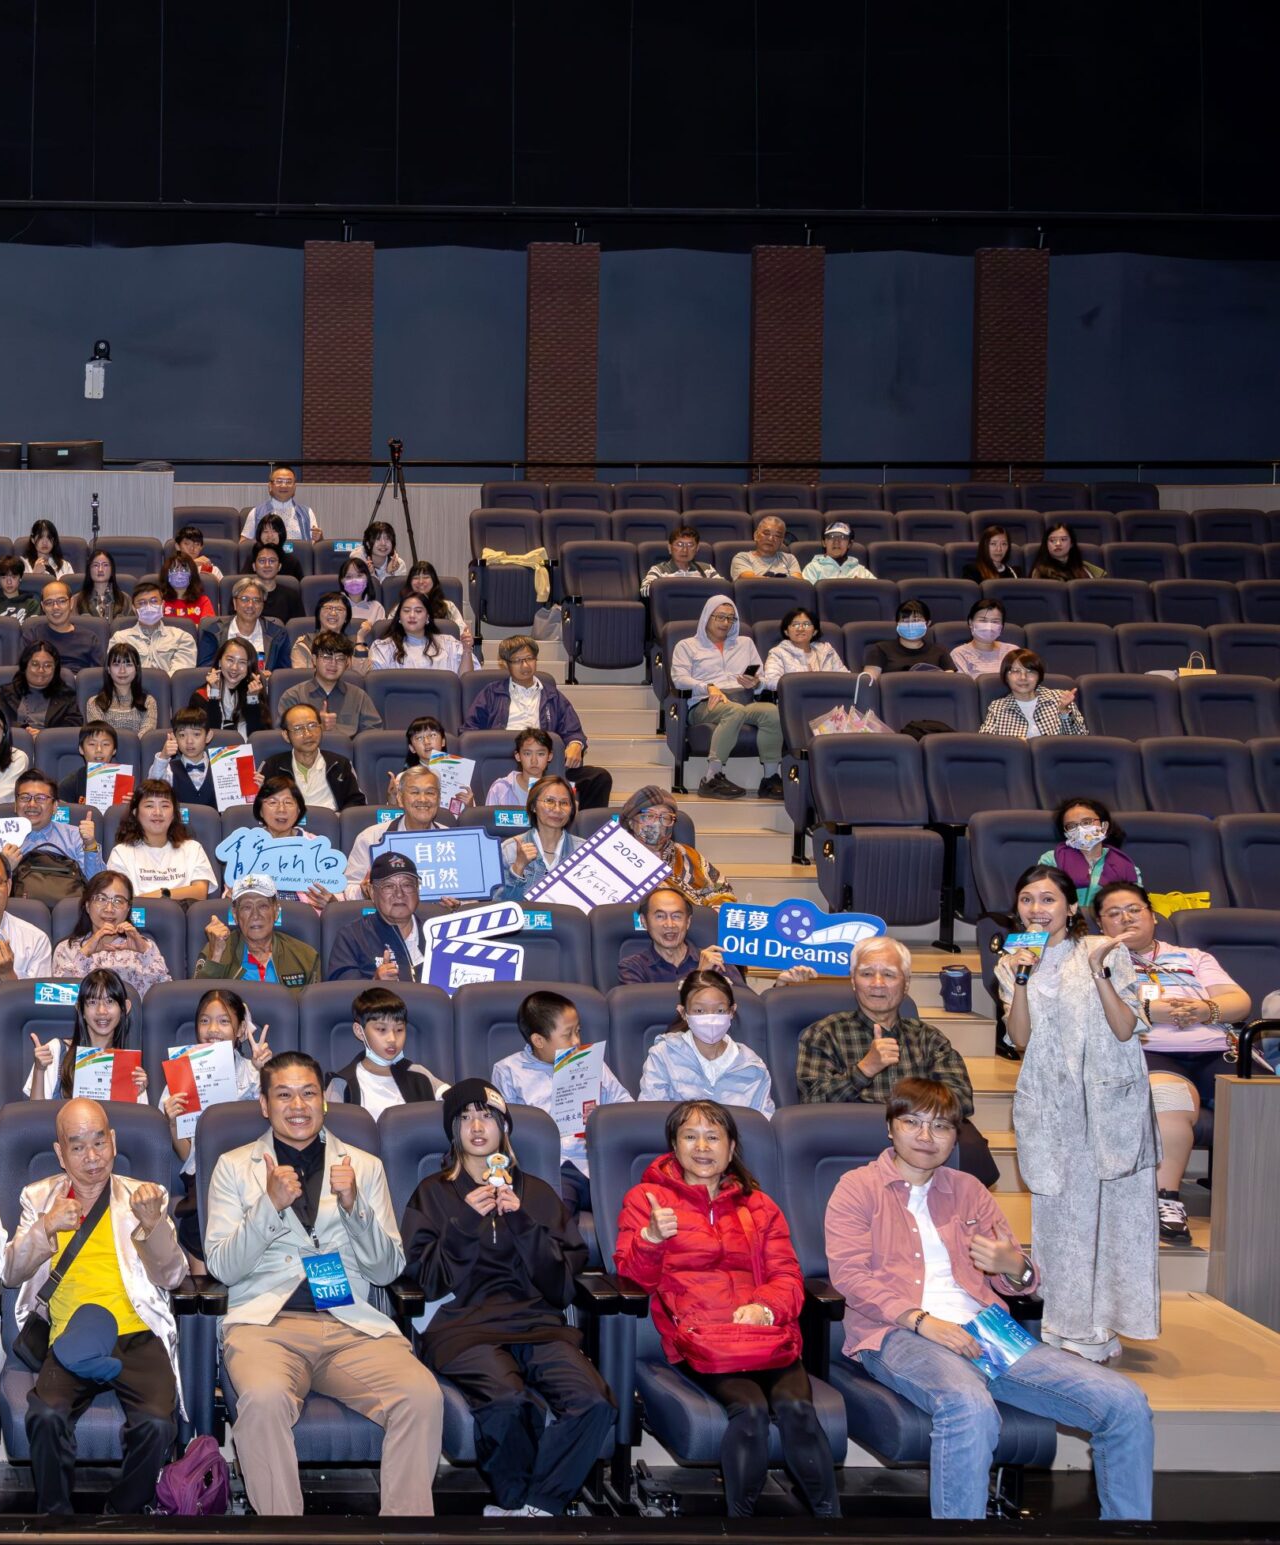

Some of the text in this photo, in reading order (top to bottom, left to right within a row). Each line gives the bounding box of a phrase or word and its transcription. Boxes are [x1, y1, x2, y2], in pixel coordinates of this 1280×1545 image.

[498, 812, 526, 825] 保留
[415, 840, 457, 864] 自然
[612, 840, 646, 869] 2025
[417, 867, 459, 890] 而然
[523, 914, 548, 926] 留席
[726, 908, 769, 931] 舊夢
[723, 935, 849, 965] Old Dreams
[39, 987, 73, 1004] 保留
[315, 1283, 346, 1299] STAFF
